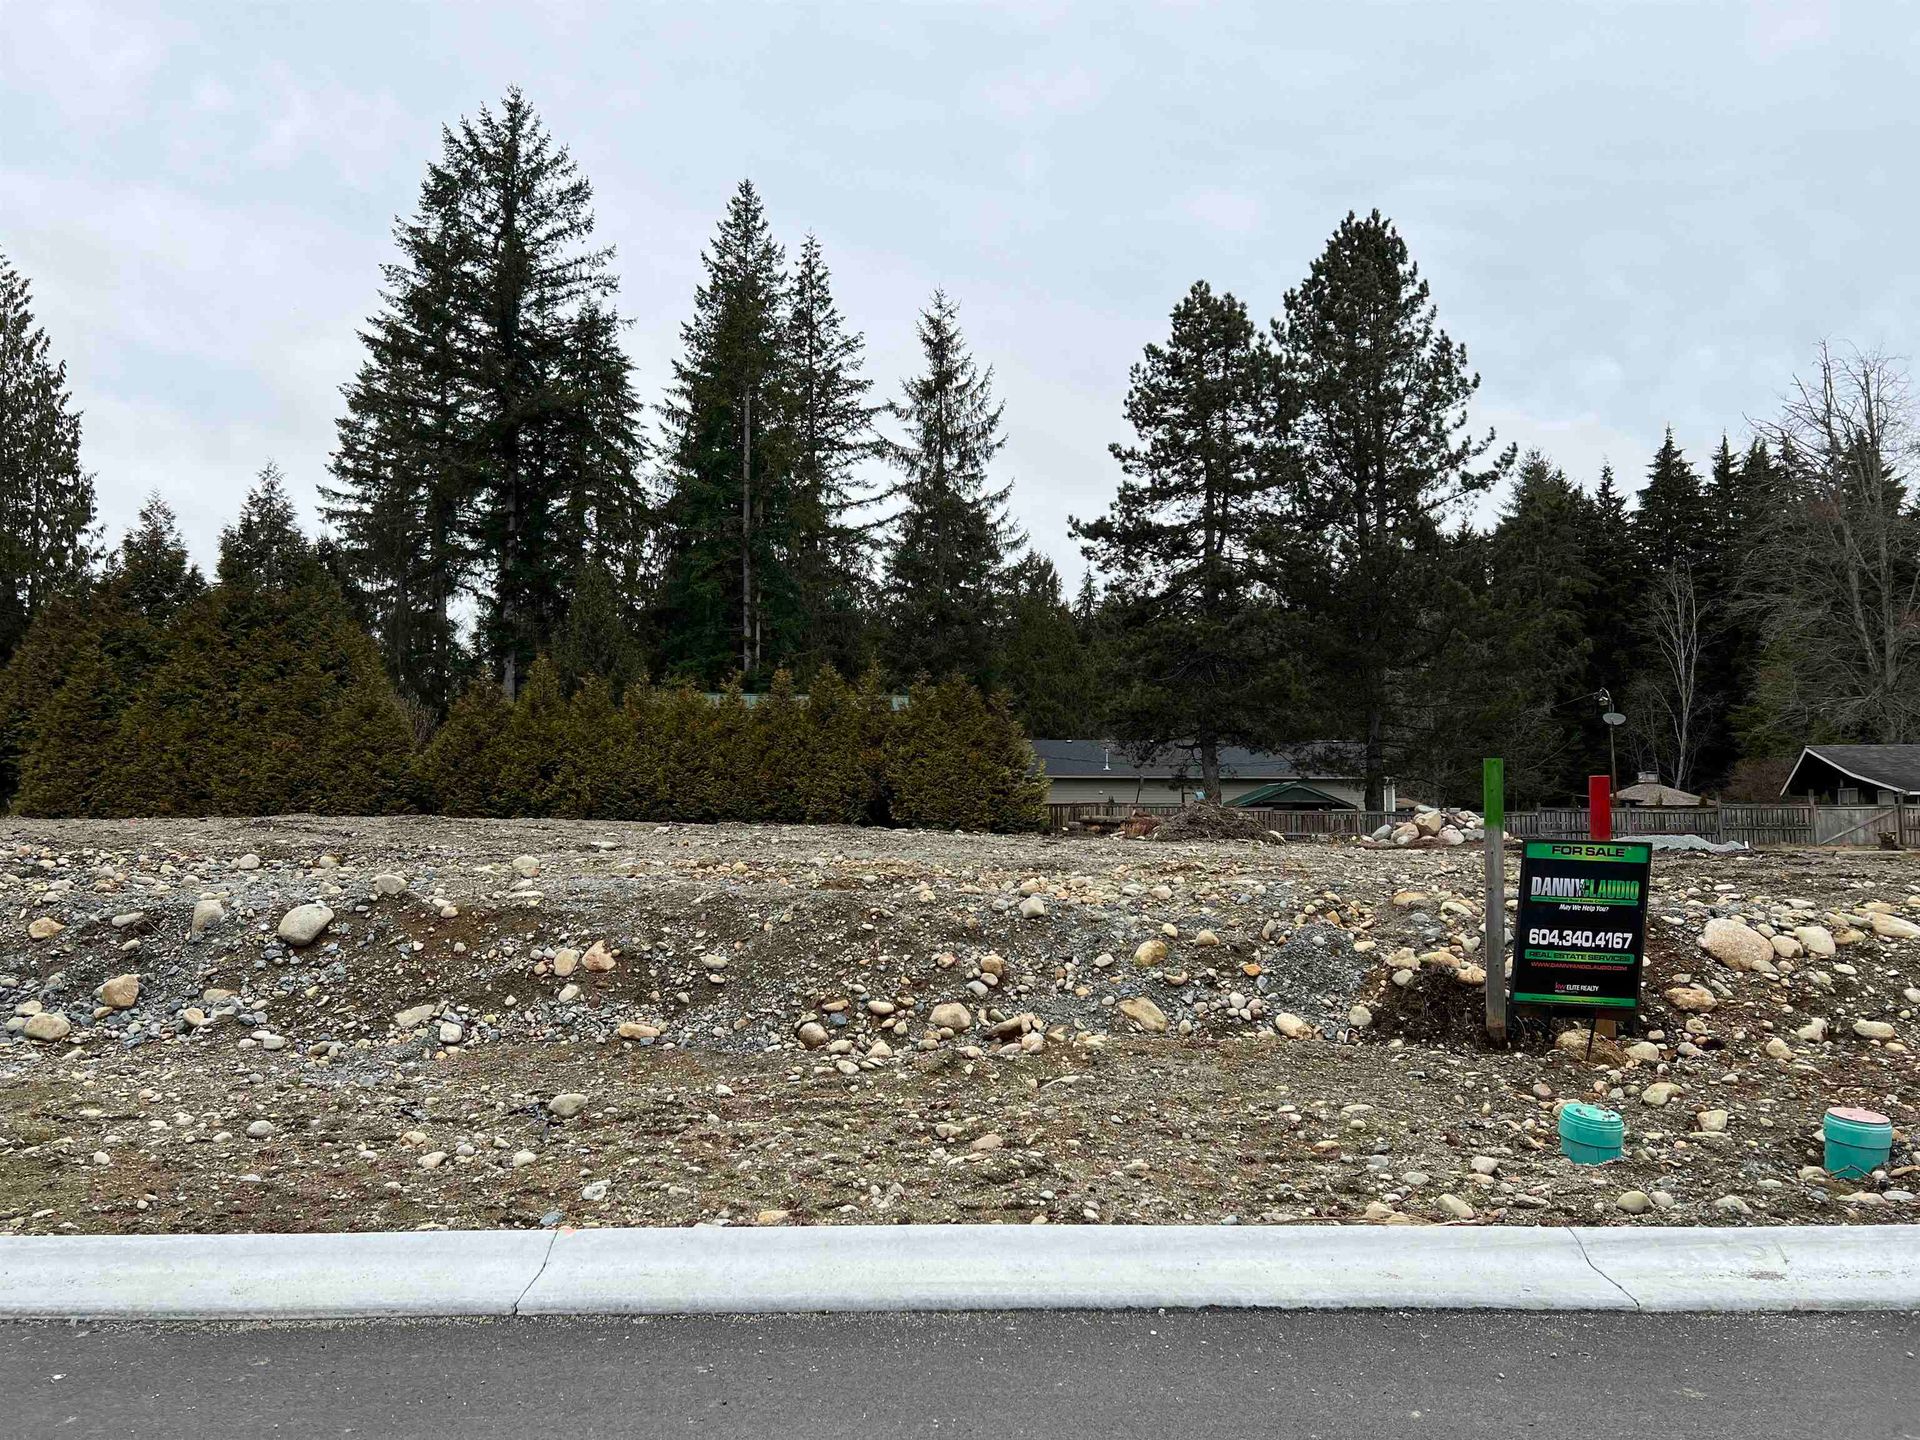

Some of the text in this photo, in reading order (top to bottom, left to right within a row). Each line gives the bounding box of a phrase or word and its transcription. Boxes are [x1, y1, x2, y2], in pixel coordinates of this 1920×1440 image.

[1551, 845, 1626, 858] FOR SALE
[1530, 876, 1640, 900] DANNY CLAUDIO
[1559, 903, 1571, 911] May
[1582, 904, 1596, 912] Help
[1529, 928, 1633, 949] 604.340.4167
[1528, 951, 1631, 962] REAL ESTATE SERVICES
[1580, 984, 1599, 992] REALTY
